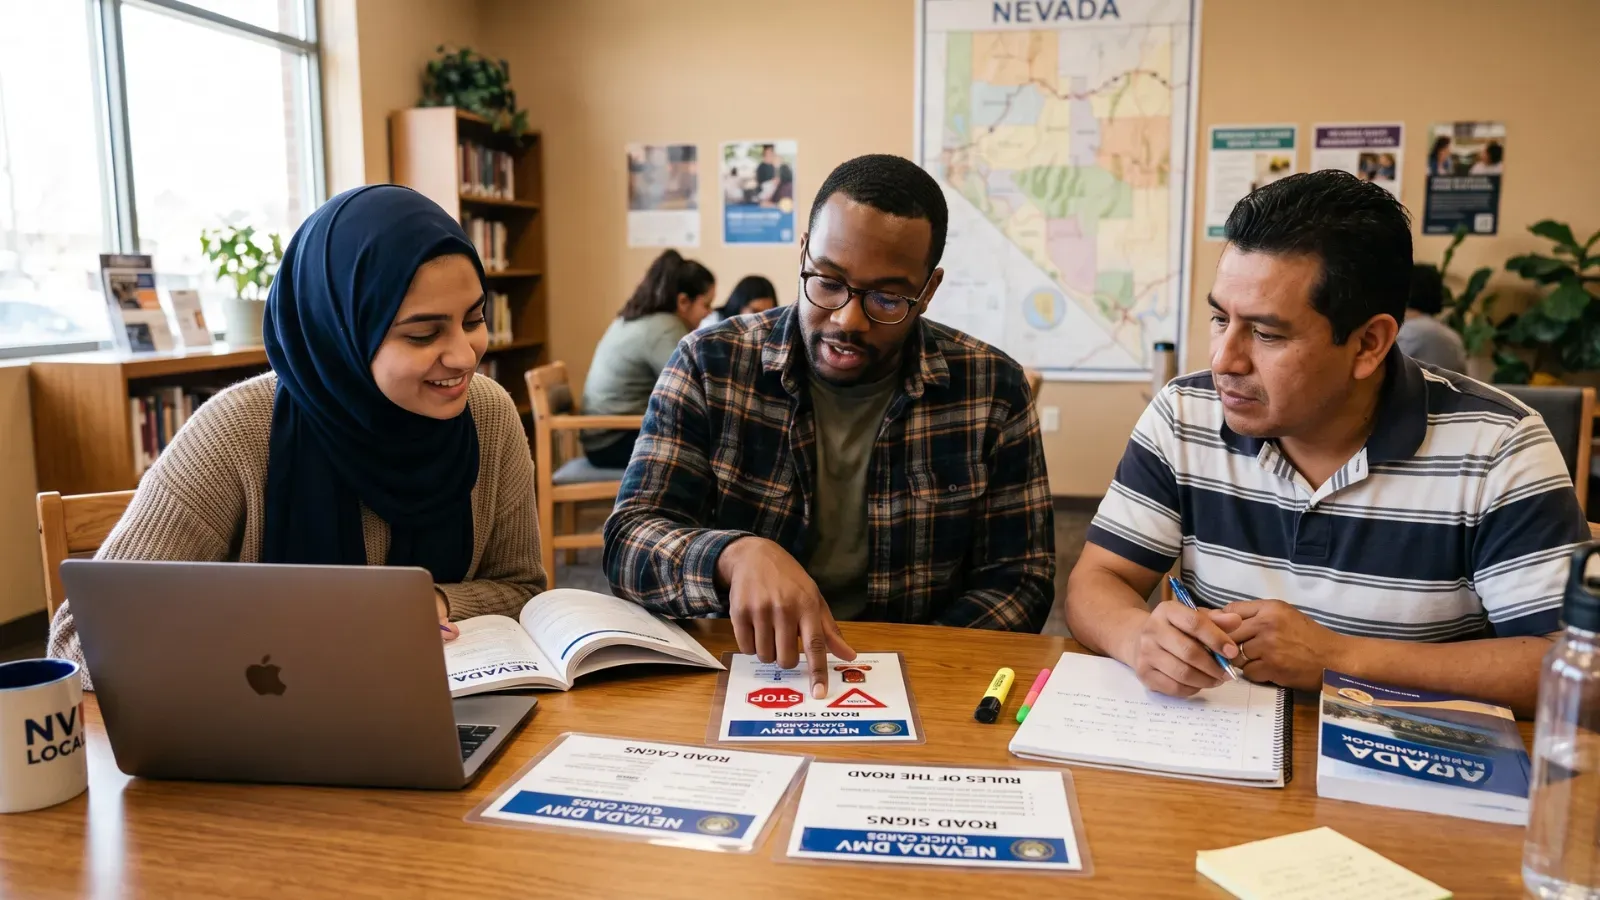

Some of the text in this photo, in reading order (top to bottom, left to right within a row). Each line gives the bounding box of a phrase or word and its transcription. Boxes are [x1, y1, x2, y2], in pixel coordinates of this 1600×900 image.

[993, 0, 1120, 23] NEVADA
[453, 664, 539, 682] NEVADA
[751, 694, 800, 703] STOP
[25, 706, 77, 746] NV
[27, 731, 86, 765] LOCAL
[623, 746, 731, 763] ROAD CAGNS
[1341, 733, 1430, 758] HANDBOOK
[847, 770, 1022, 785] RULES OF THE ROAD
[571, 799, 663, 815] QUICK CARDS
[536, 804, 684, 830] NEVADA DMV
[866, 815, 998, 830] ROAD SIGNS
[866, 832, 968, 845] QUICK CARDS
[835, 839, 997, 859] NEVADA DMV
